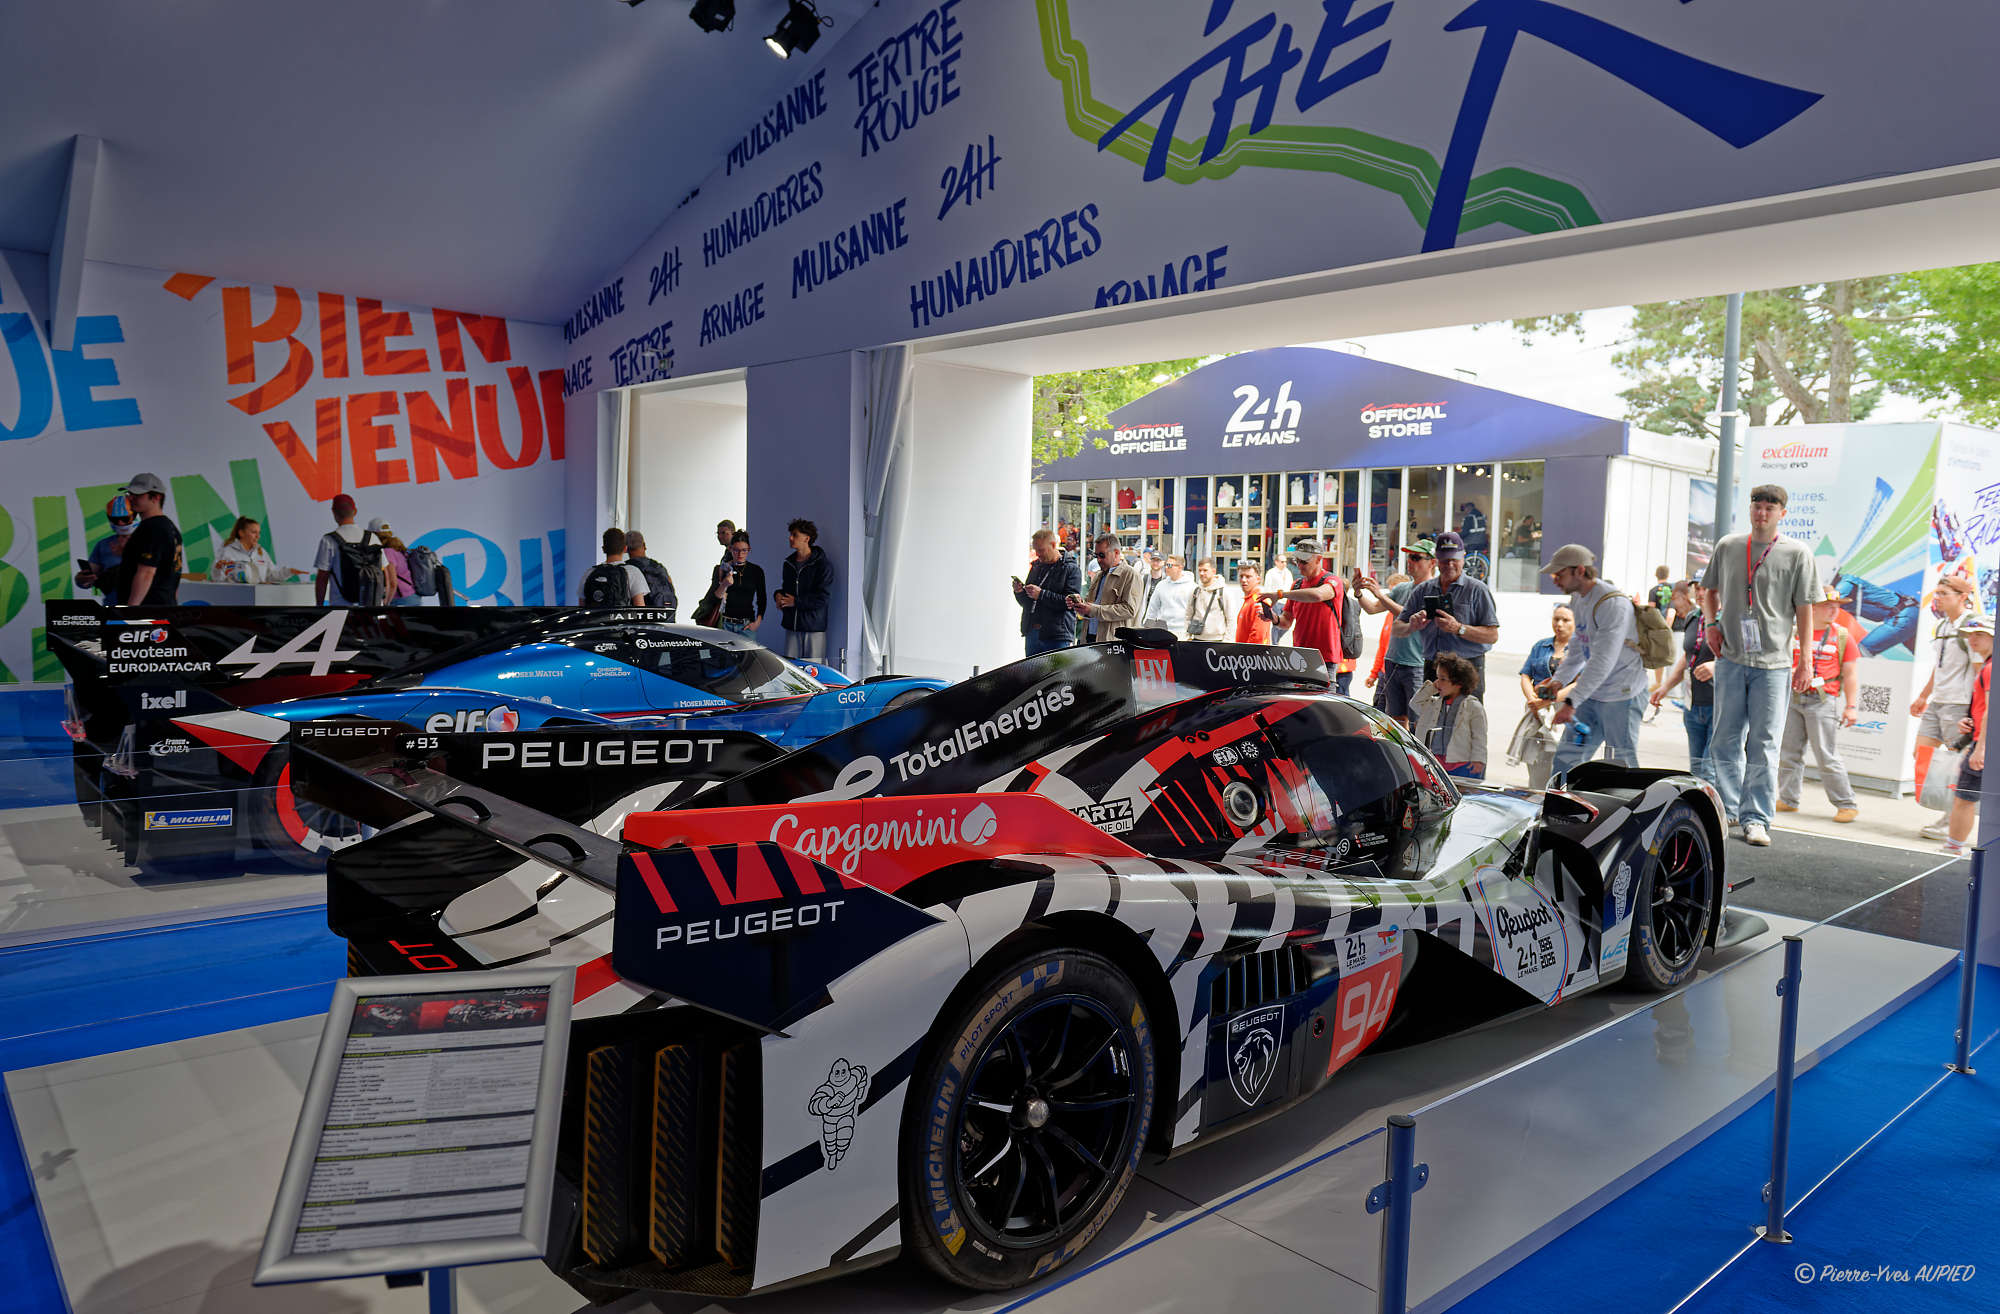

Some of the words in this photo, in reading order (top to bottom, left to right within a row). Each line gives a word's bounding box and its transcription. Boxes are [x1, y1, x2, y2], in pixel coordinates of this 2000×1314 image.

[848, 0, 963, 107] TERTRE
[854, 48, 961, 157] ROUGE
[1098, 0, 1394, 182] THE
[726, 68, 827, 176] MULSANNE
[937, 134, 1002, 221] 24H
[703, 161, 824, 268] HUNAUDIERES
[792, 198, 909, 299] MULSANNE
[648, 245, 683, 306] 24H
[910, 203, 1102, 329] HUNAUDIERES
[699, 282, 766, 347] ARNAGE
[220, 284, 512, 415] BIEN
[1225, 380, 1302, 433] 24h
[1360, 405, 1447, 424] OFFICIAL
[1113, 425, 1184, 442] BOUTIQUE
[1222, 433, 1244, 448] LE
[1368, 421, 1433, 439] STORE
[1110, 438, 1187, 455] OFFICIELLE
[1761, 443, 1829, 459] excellium
[1761, 462, 1788, 470] Racing
[1790, 461, 1809, 469] evo
[614, 611, 668, 620] ALTEN
[118, 630, 150, 643] elf
[648, 638, 703, 649] businessolver
[111, 646, 188, 659] devoteam
[1107, 645, 1126, 656] #94
[109, 661, 211, 673] EURODATACAR
[1205, 647, 1290, 682] Capgemini
[141, 690, 186, 709] ixell
[838, 690, 865, 705] GCR
[300, 726, 392, 737] PEUGEOT
[425, 710, 485, 734] elf
[889, 683, 1075, 783] TotalEnergies
[406, 737, 439, 749] #93
[482, 739, 724, 769] PEUGEOT
[169, 814, 229, 824] MICHELIN
[1076, 800, 1132, 823] ARTZ
[1115, 820, 1131, 830] OIL
[769, 808, 957, 874] Capgemini
[656, 900, 844, 949] PEUGEOT
[1496, 902, 1552, 949] Peugeot
[959, 1024, 985, 1060] PILOT
[983, 990, 1015, 1026] SPORT
[1231, 1012, 1280, 1034] PEUGEOT
[1336, 972, 1394, 1060] 94
[929, 1076, 956, 1213] MICHELIN
